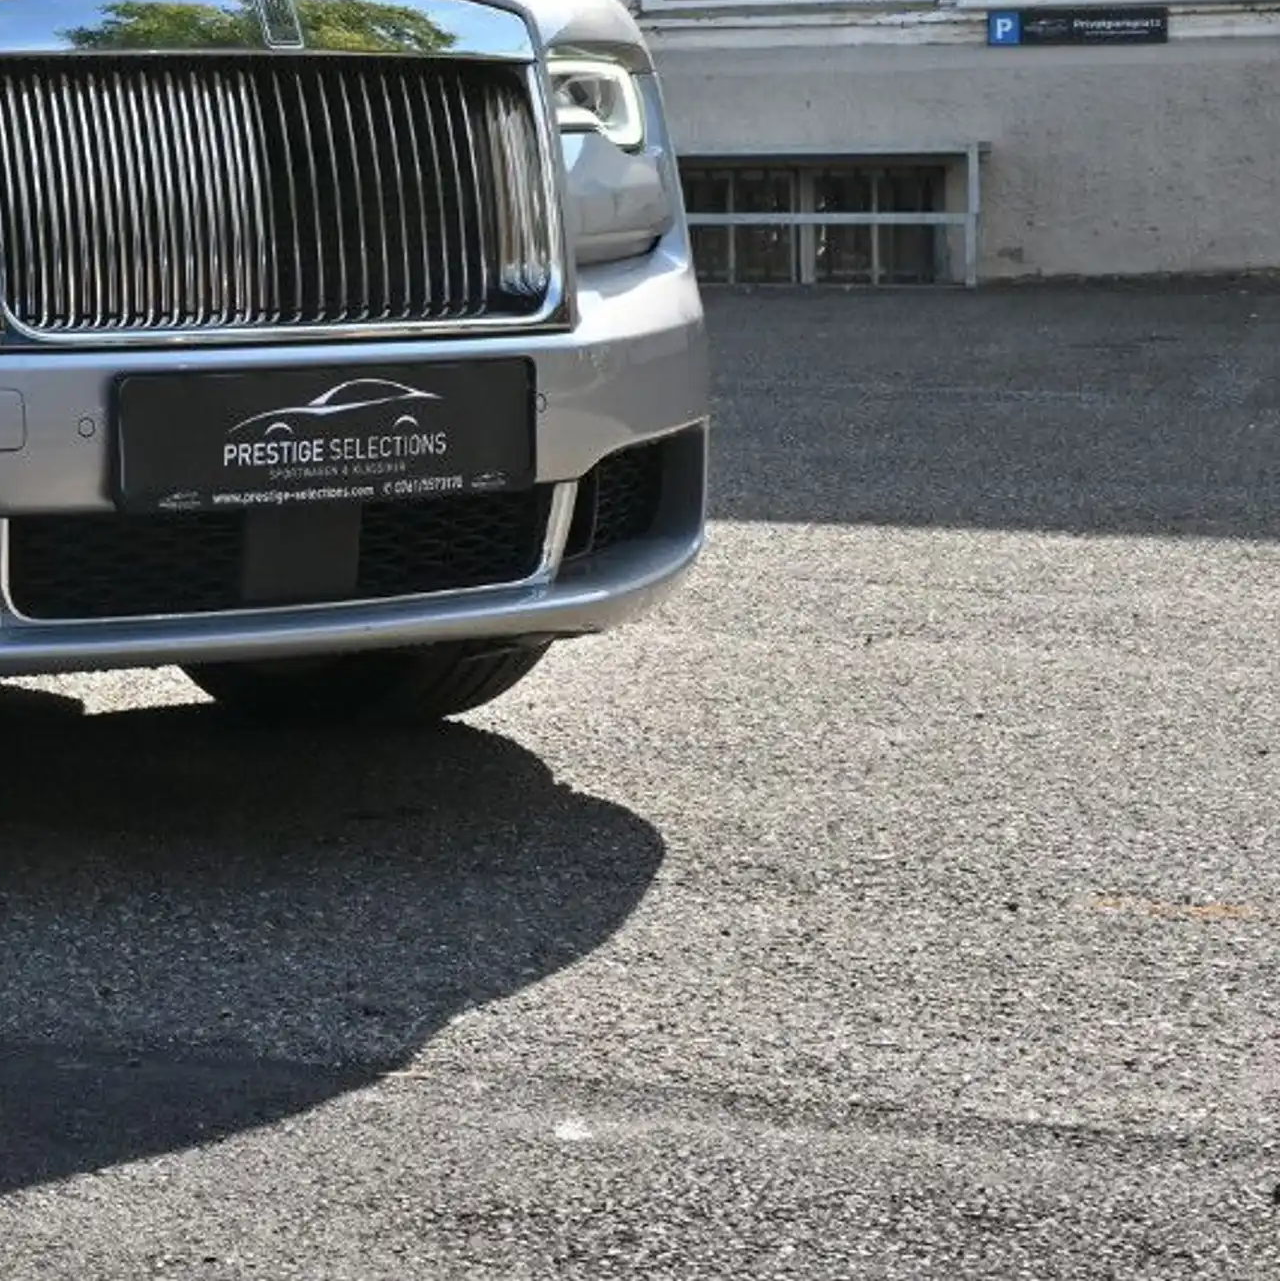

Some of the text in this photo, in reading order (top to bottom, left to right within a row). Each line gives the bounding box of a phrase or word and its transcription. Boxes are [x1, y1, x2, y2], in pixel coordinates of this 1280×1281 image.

[995, 18, 1013, 40] P
[223, 431, 447, 467] PRESTIGE SELECTIONS
